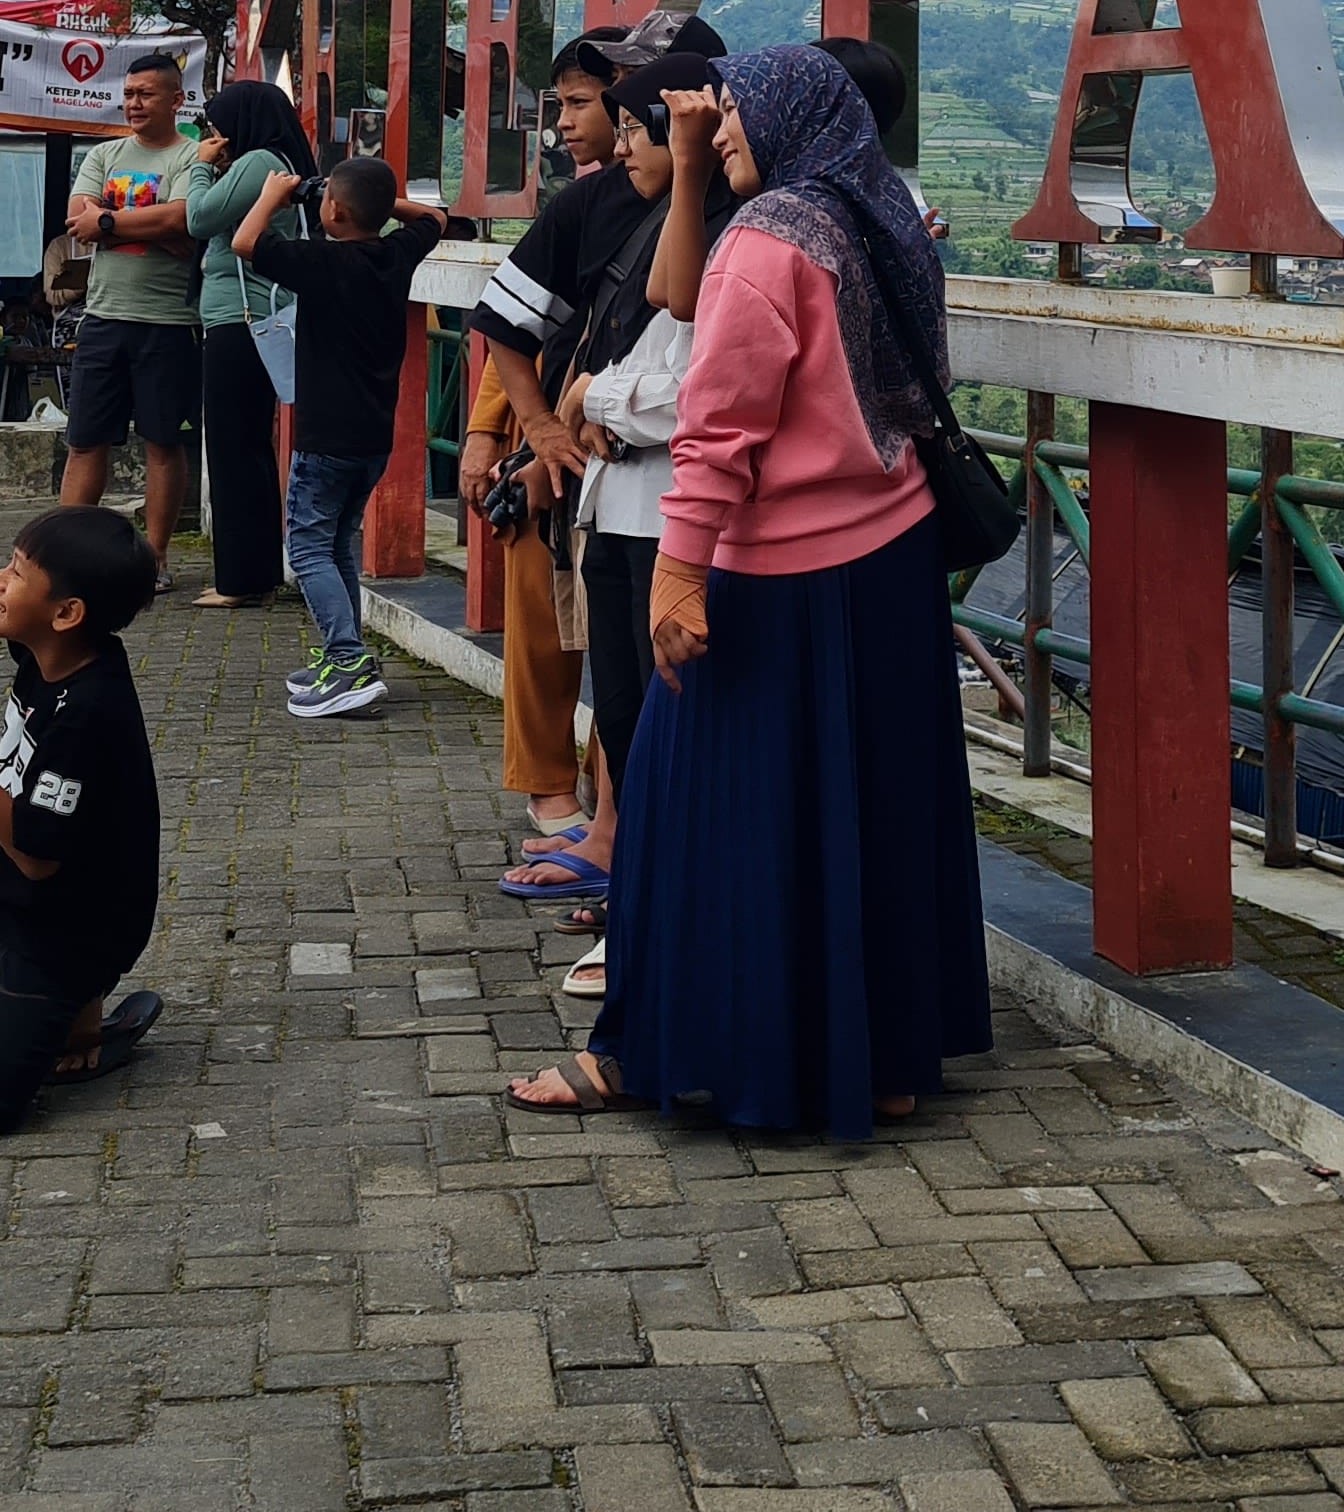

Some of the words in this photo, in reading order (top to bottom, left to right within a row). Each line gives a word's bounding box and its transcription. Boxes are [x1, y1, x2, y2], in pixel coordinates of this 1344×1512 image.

[45, 85, 81, 98] KETEP
[83, 88, 112, 101] PASS
[52, 96, 103, 109] MAGELANG
[30, 770, 82, 816] 28
